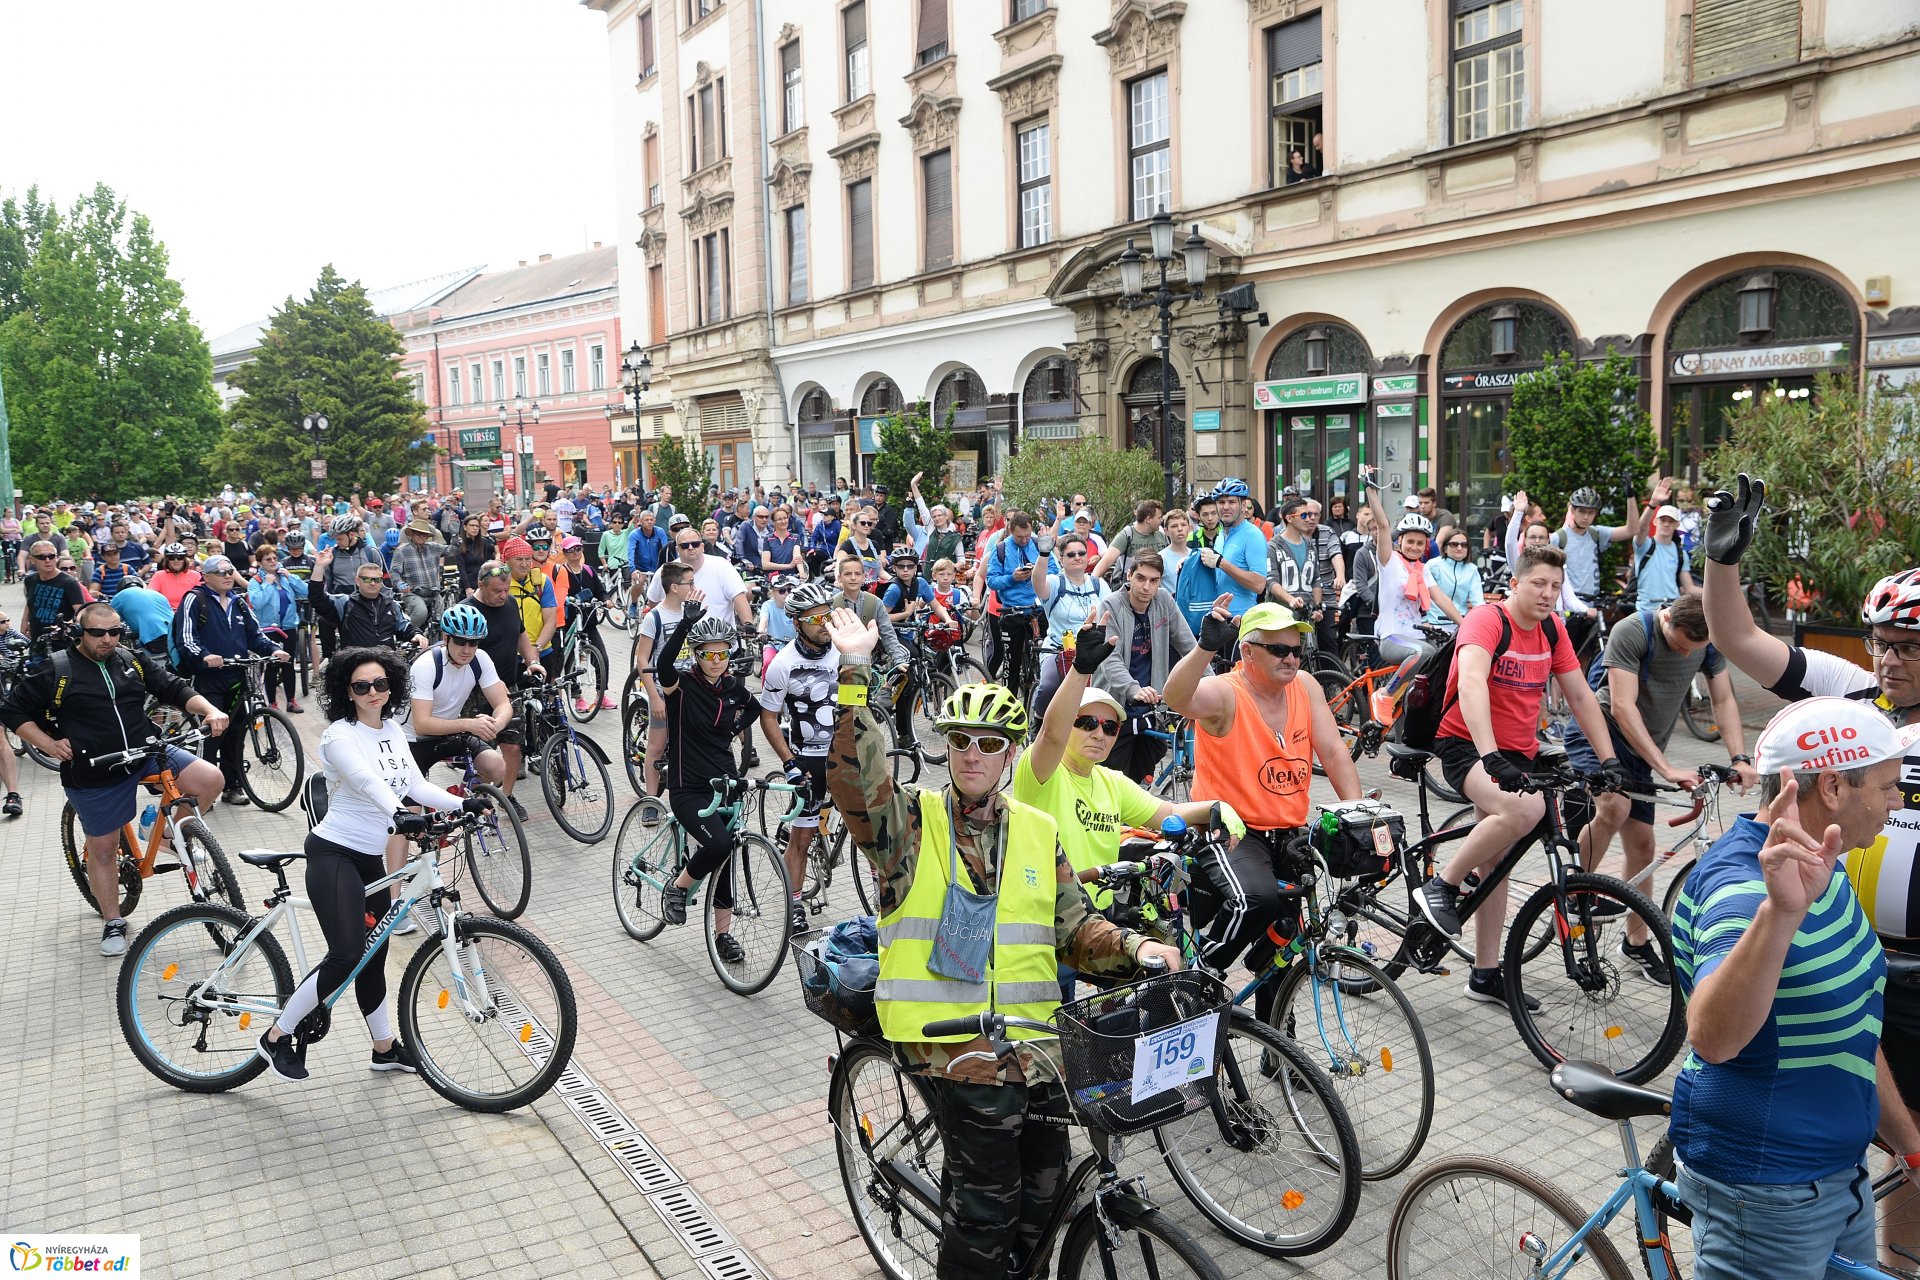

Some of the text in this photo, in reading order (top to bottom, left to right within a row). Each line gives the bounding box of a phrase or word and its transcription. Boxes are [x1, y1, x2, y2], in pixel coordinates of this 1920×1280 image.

[1685, 349, 1837, 372] ZSOLNAY MÁRKABOLT
[1306, 387, 1333, 396] Centrum
[1336, 382, 1356, 394] FDF
[462, 429, 495, 442] NYÍRSÉG
[34, 584, 64, 598] TESTO
[378, 739, 393, 753] IT
[1796, 726, 1858, 751] Cilo
[1801, 745, 1870, 770] aufina
[949, 902, 989, 927] ALDI
[940, 916, 993, 942] AUCHAN
[1153, 1032, 1196, 1070] 159
